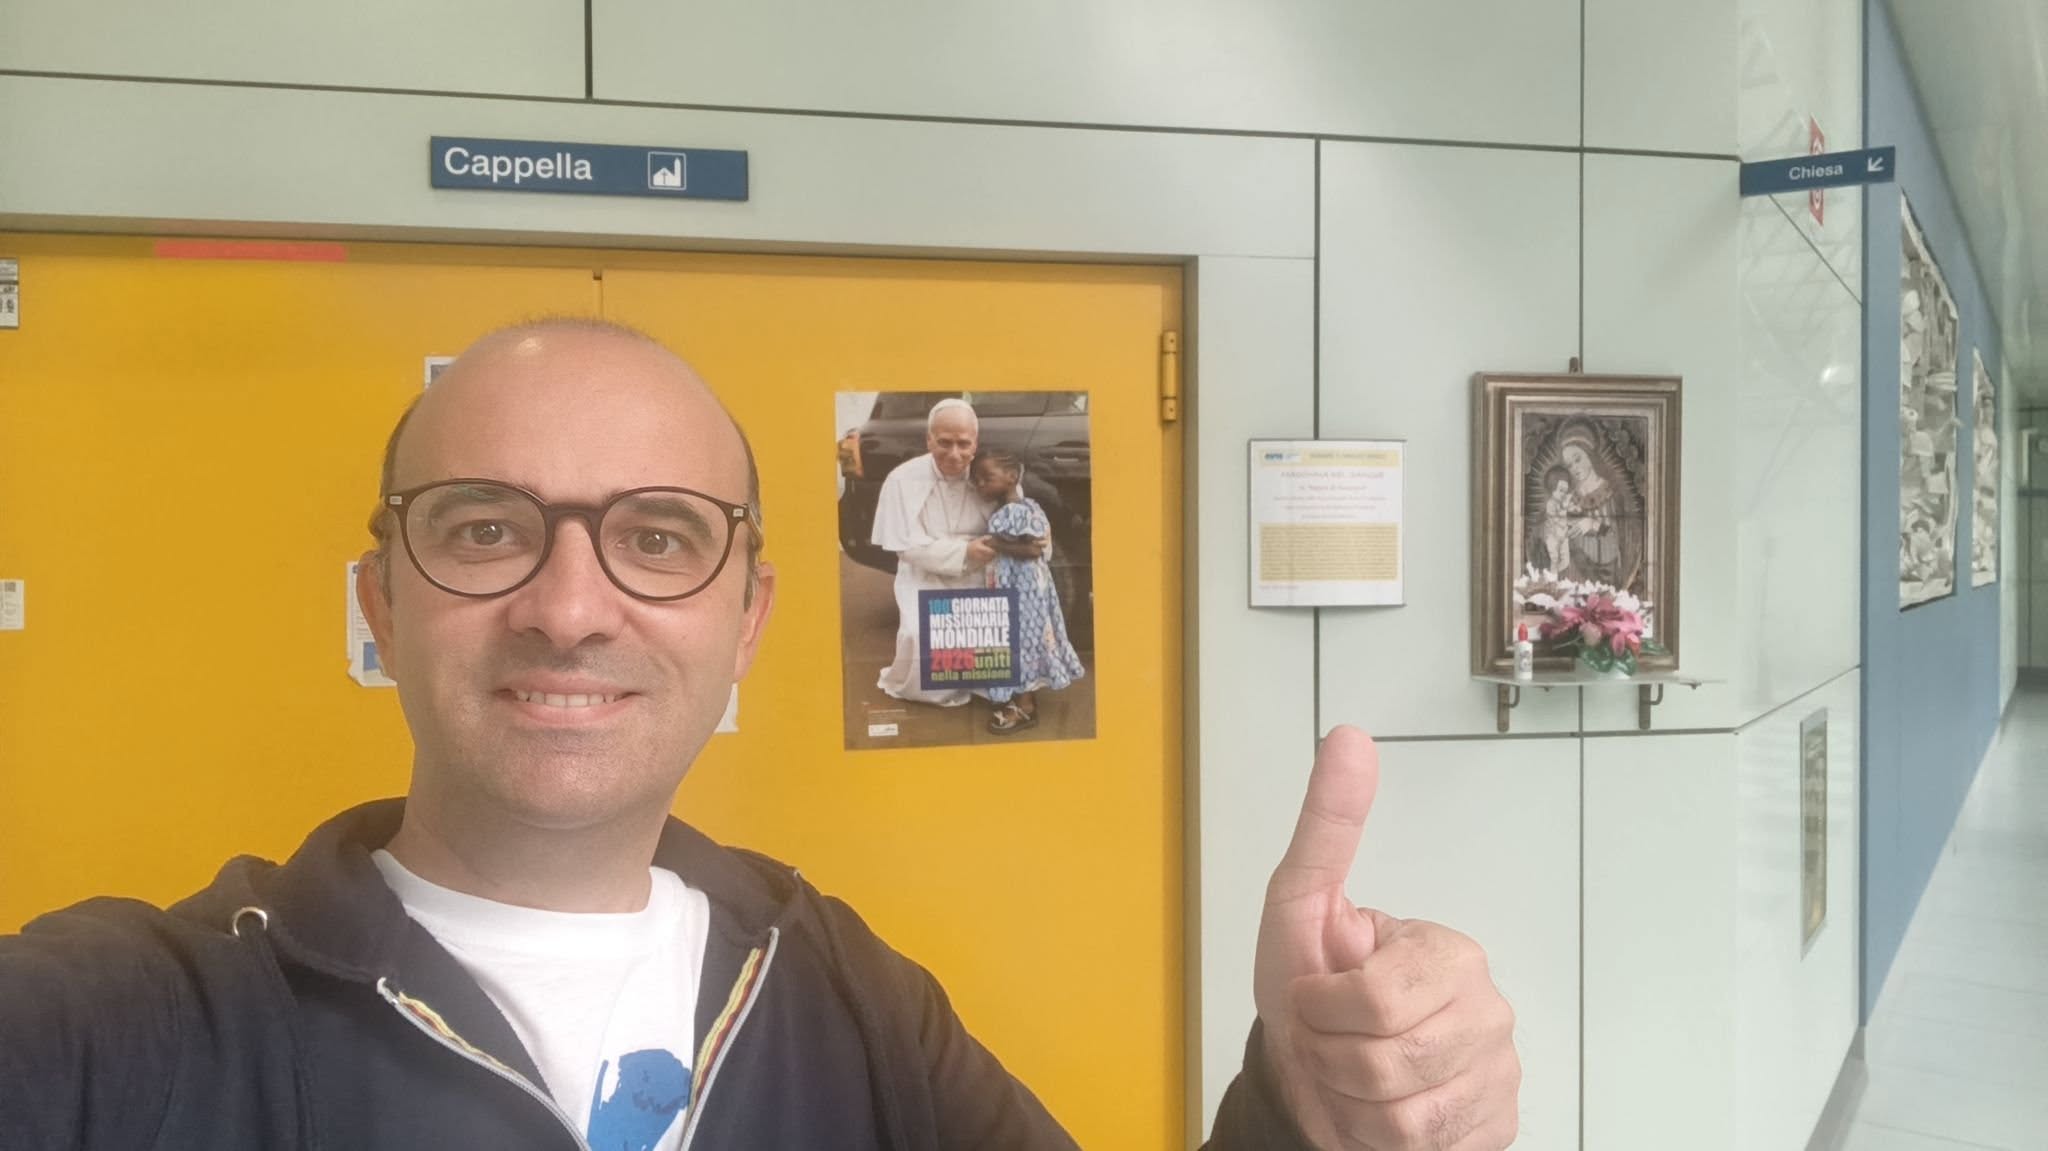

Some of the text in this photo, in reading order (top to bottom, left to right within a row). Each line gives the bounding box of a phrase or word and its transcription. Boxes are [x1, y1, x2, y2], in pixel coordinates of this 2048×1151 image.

[444, 147, 593, 184] Cappella
[1788, 164, 1843, 180] Chiesa
[951, 597, 1010, 613] GIORNATA
[929, 612, 1011, 629] MISSIONARIA
[930, 627, 1011, 649] MONDIALE
[931, 648, 1011, 671] 2026 uniti
[931, 668, 1012, 681] nella missione
